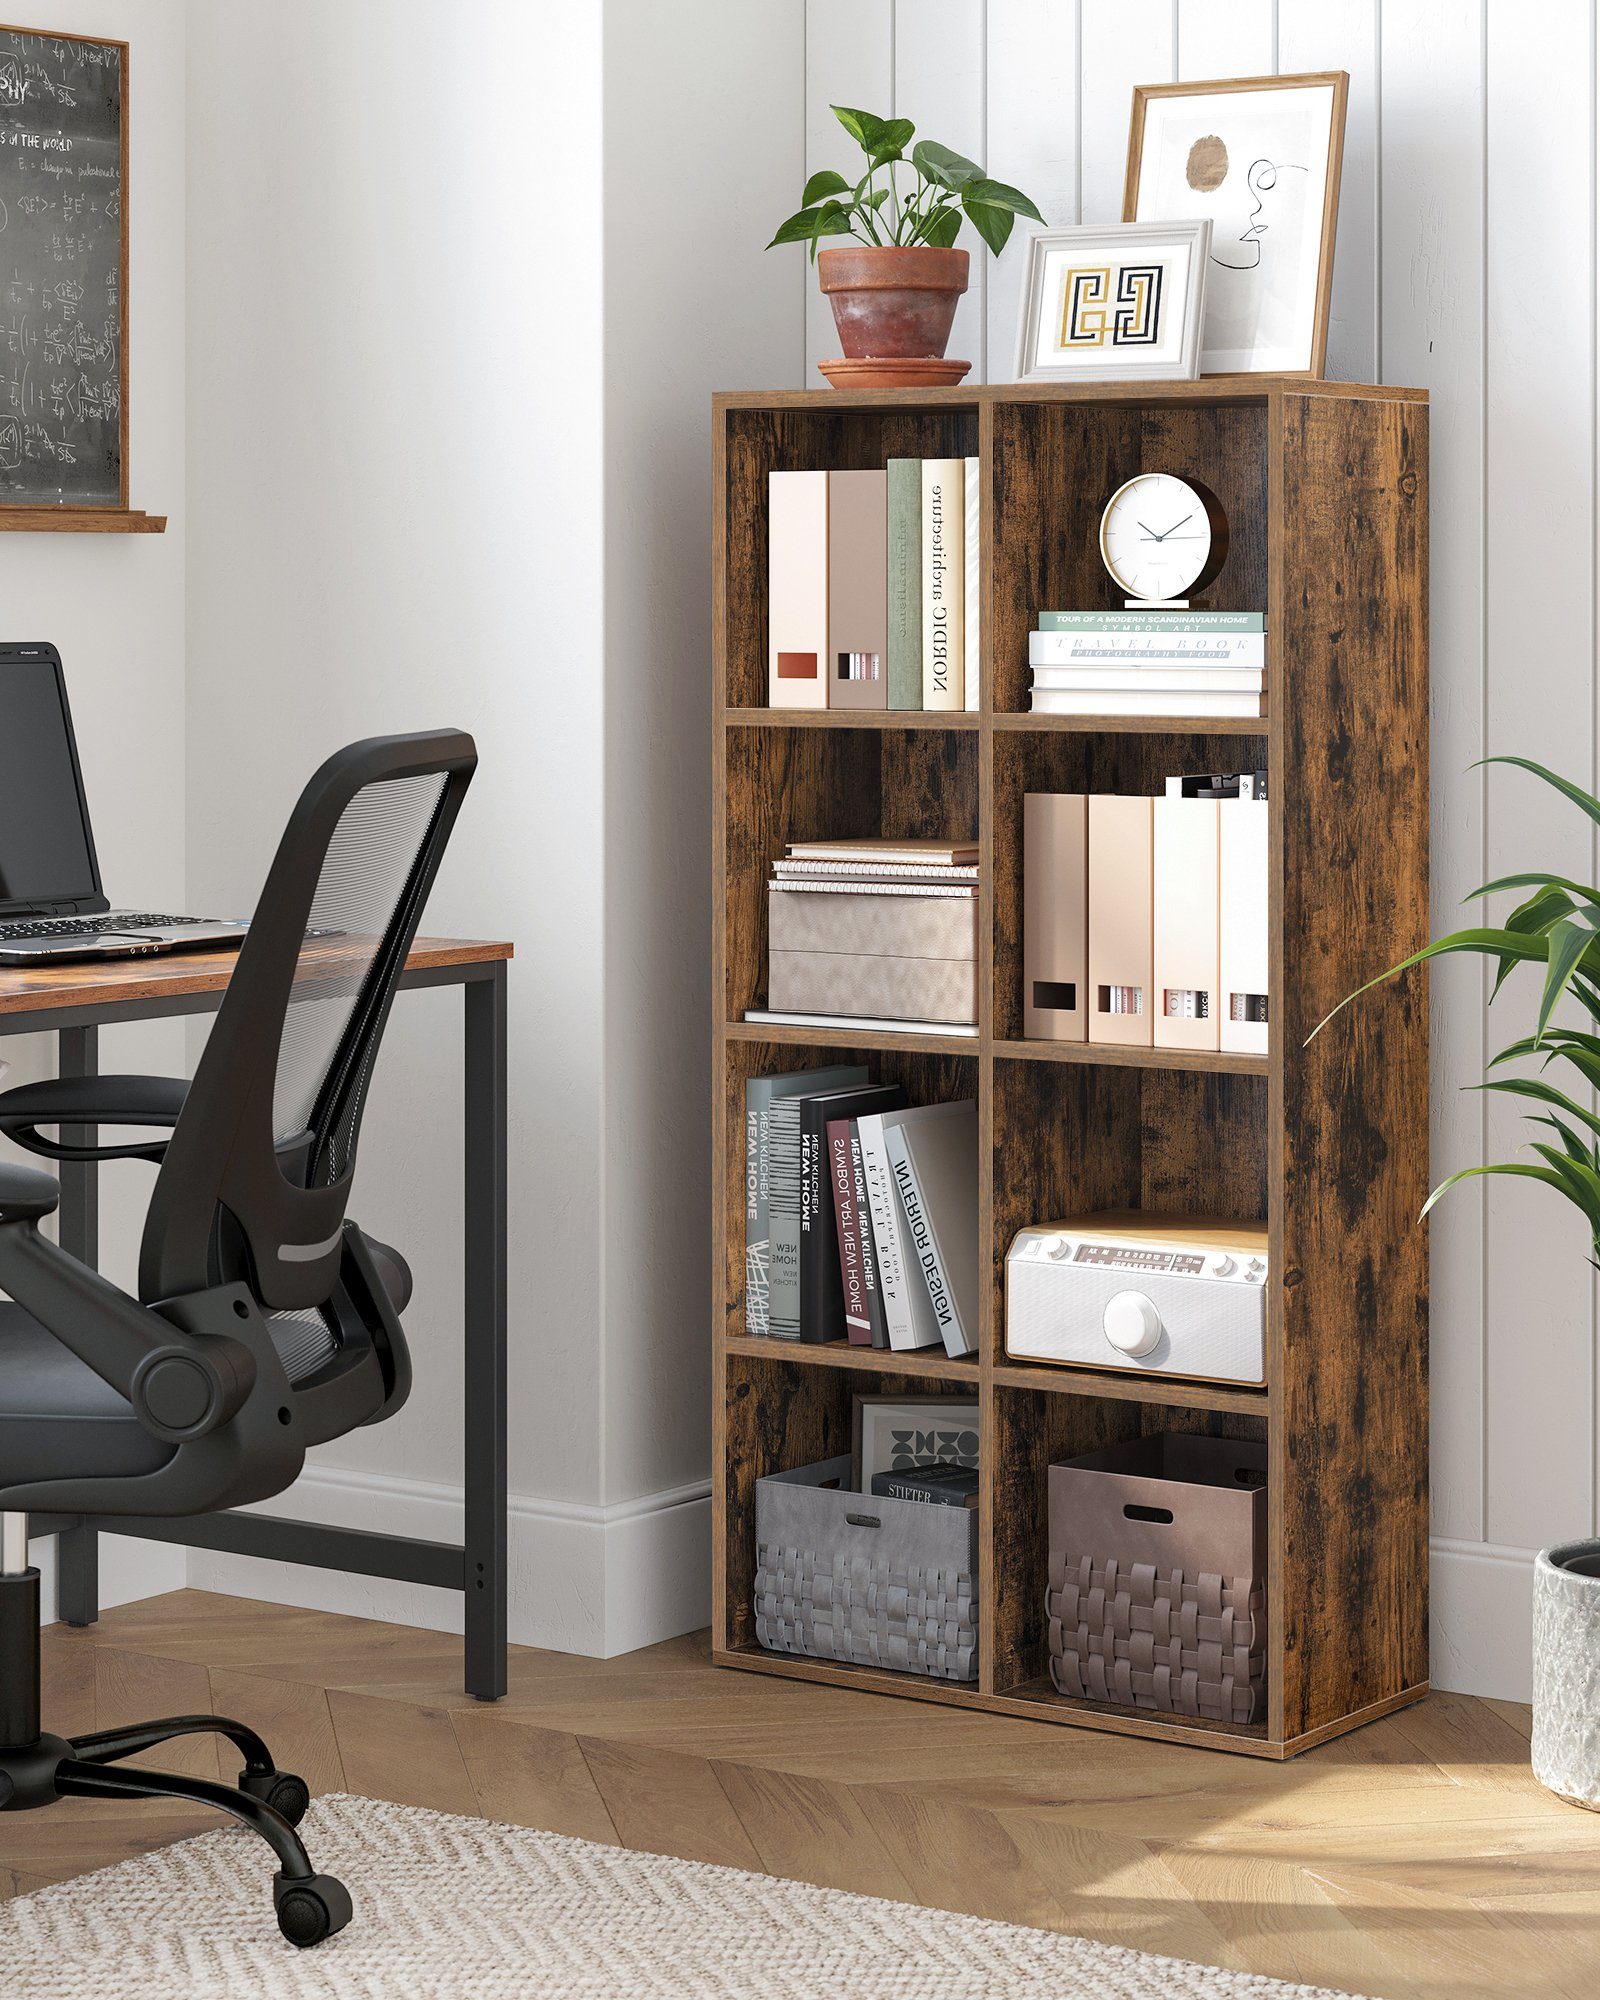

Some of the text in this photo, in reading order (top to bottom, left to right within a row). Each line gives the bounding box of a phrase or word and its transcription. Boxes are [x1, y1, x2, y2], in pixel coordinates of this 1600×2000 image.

[21, 133, 40, 149] THE
[43, 138, 73, 152] WORLD
[1056, 615, 1081, 623] TOUR
[1083, 615, 1095, 623] OF
[1147, 616, 1217, 624] SCANDINAVIAN
[1056, 639, 1248, 650] TRAVEL BOOK
[888, 1483, 931, 1503] STIFTER
